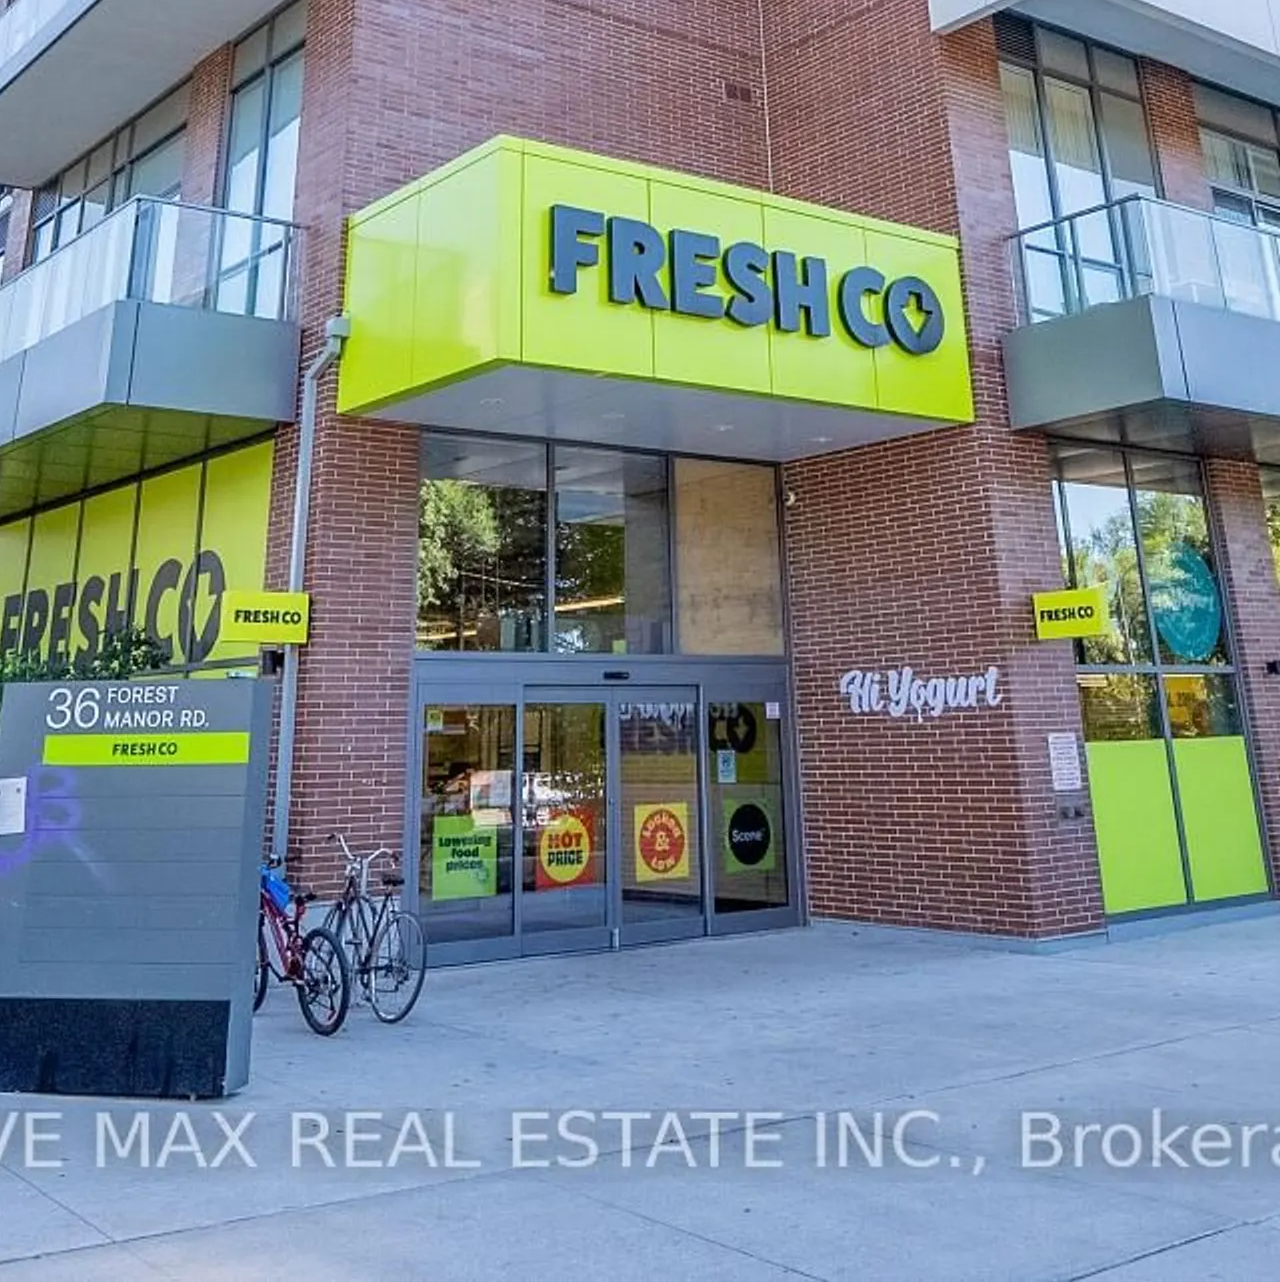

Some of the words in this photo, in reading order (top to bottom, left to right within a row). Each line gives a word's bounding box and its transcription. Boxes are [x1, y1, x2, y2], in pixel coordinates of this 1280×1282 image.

[840, 670, 885, 714] Hi
[887, 666, 1002, 721] Yogurt
[46, 687, 101, 729] 36
[107, 686, 179, 704] FOREST
[103, 710, 174, 729] MANOR
[179, 710, 210, 728] RD.
[438, 834, 492, 848] Lowering
[547, 830, 583, 849] HOT
[451, 846, 480, 859] food
[547, 849, 584, 867] PRICE
[446, 859, 484, 873] prices
